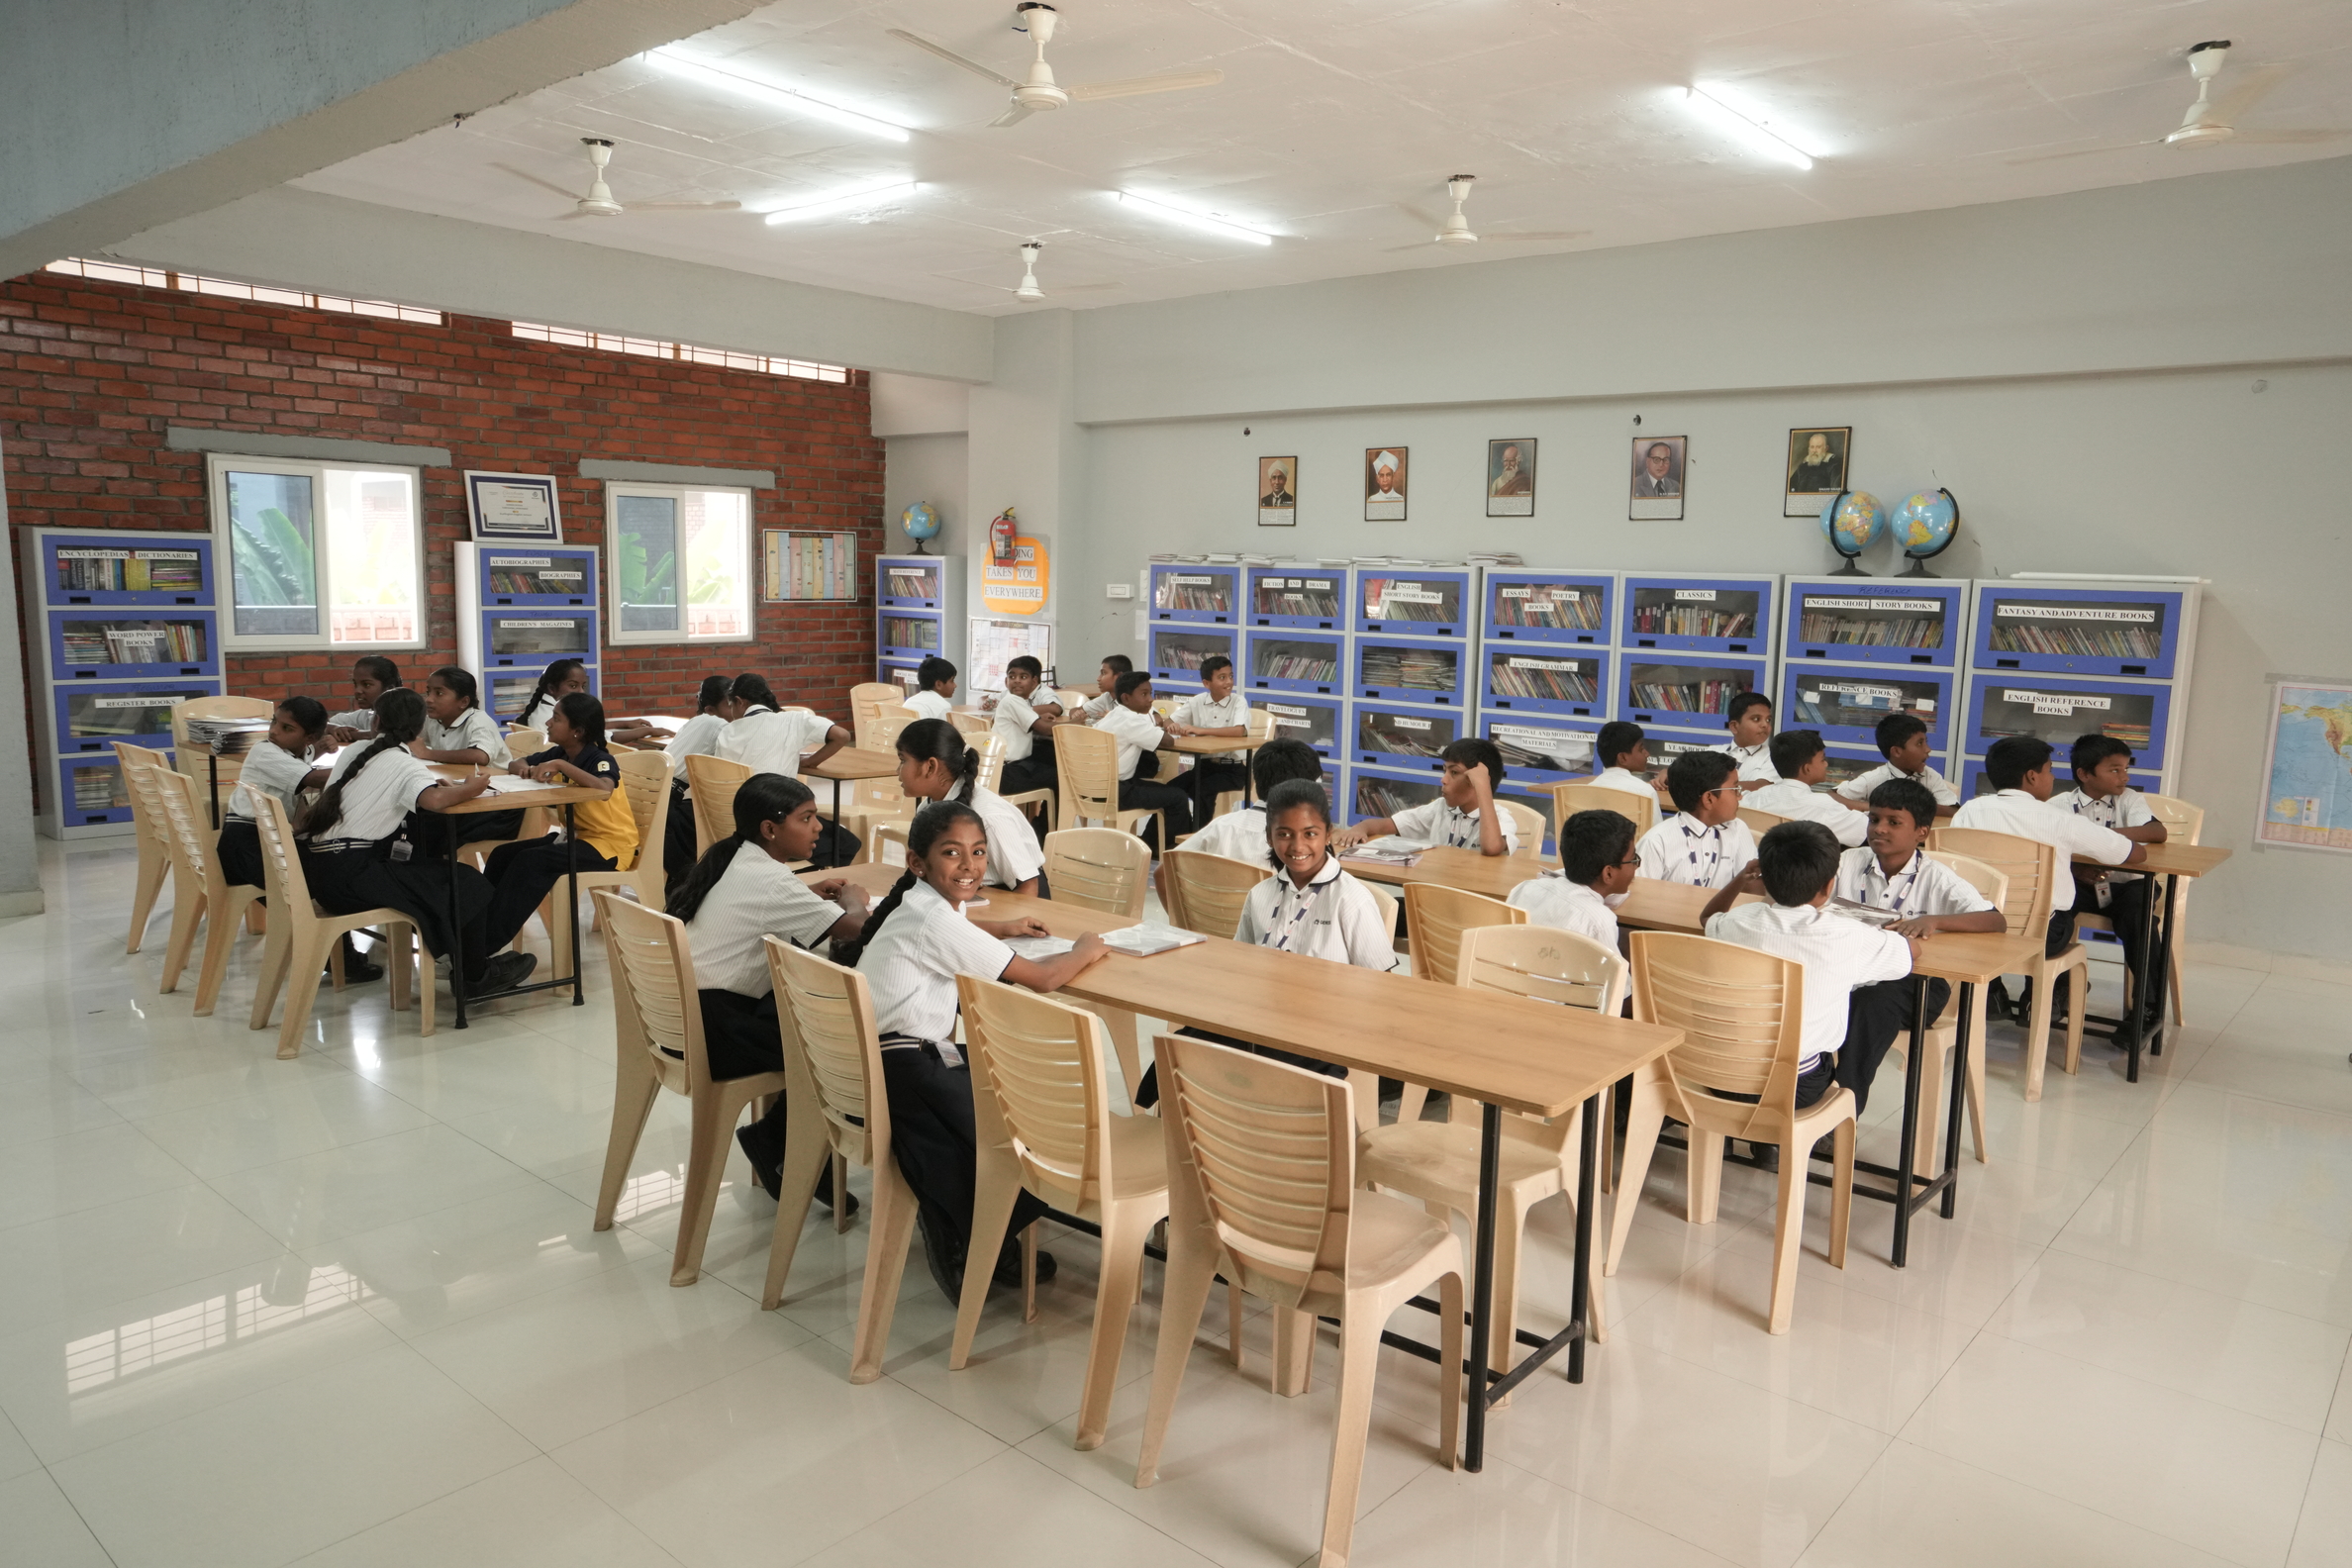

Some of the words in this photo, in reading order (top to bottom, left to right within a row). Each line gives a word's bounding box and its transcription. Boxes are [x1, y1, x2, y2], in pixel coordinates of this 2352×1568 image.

[986, 567, 1012, 577] TAKES
[1018, 568, 1036, 578] YOU
[985, 586, 1042, 598] EVERYWHERE.
[2059, 610, 2117, 619] ADVENTURE
[1869, 688, 1898, 697] BOOKS
[2008, 694, 2047, 703] ENGLISH
[2050, 697, 2107, 708] REFERENCE
[1268, 705, 1306, 715] TRAVELOGUES
[2037, 706, 2070, 715] BOOKS
[1492, 726, 1538, 736] RECREATIONAL
[1551, 732, 1597, 740] MOTIVATIONAL
